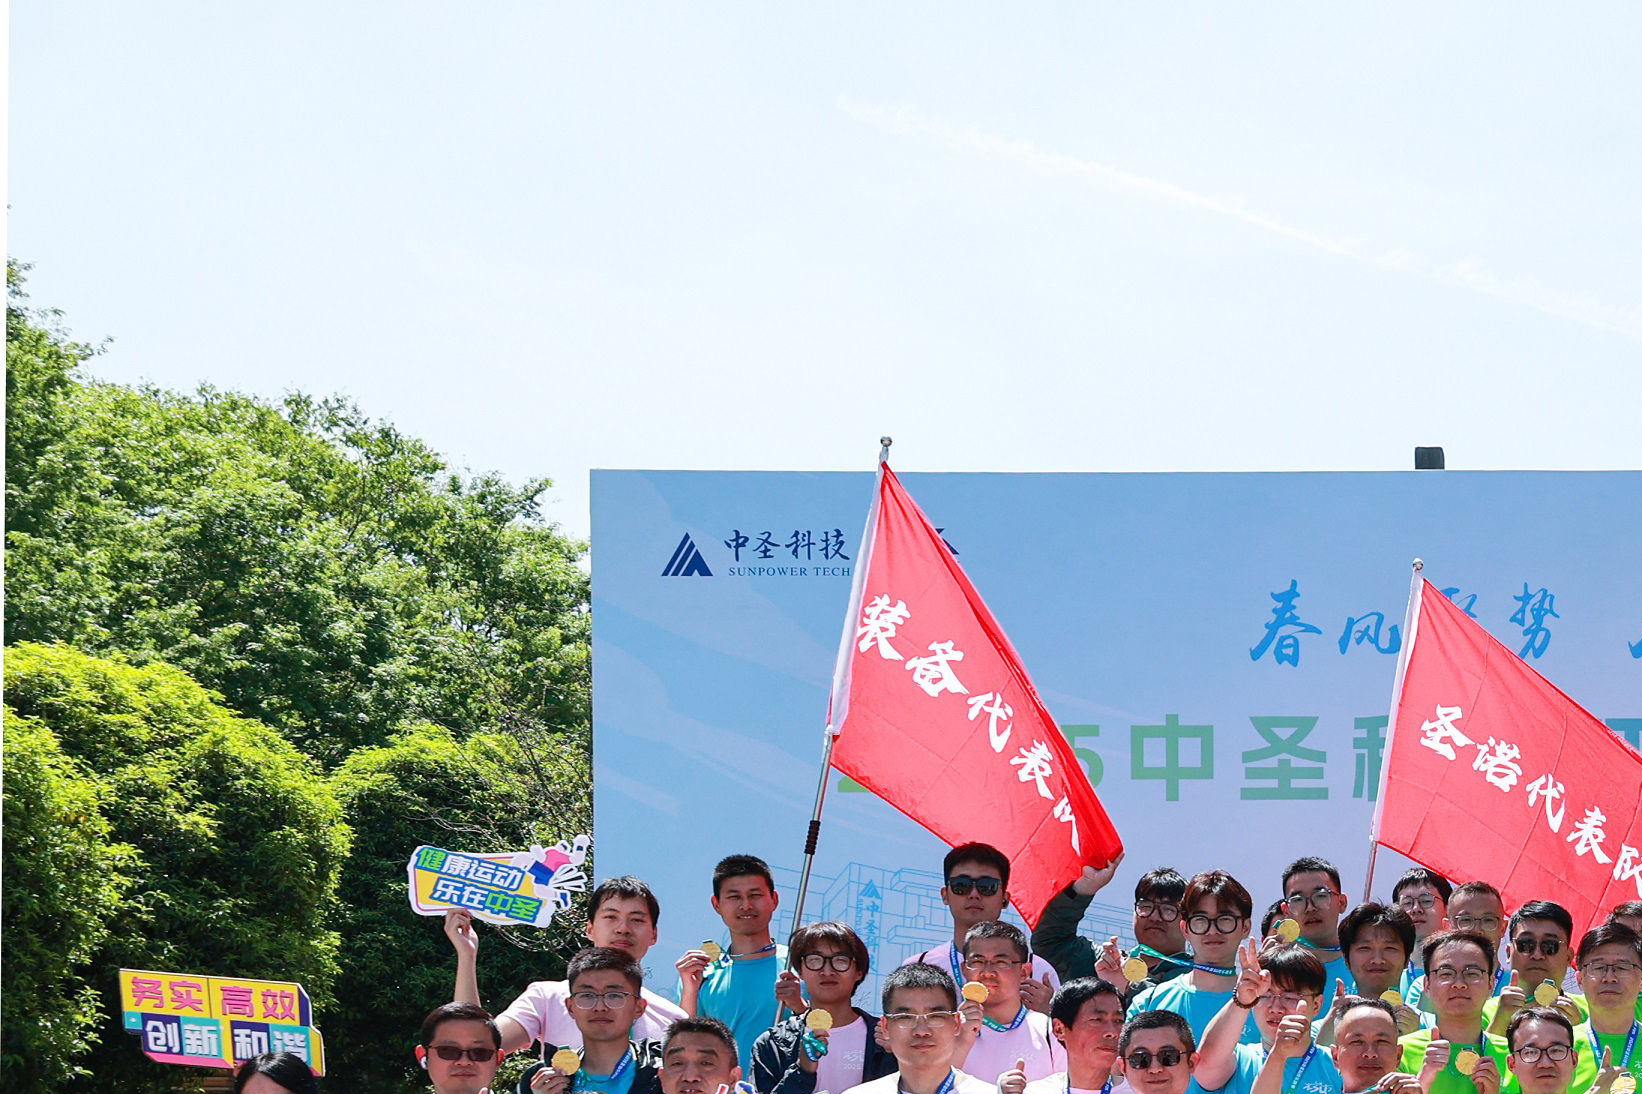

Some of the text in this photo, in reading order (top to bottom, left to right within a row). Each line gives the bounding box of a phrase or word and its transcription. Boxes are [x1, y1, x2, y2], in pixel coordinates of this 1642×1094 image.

[724, 529, 850, 562] 中圣科技
[728, 566, 850, 577] SUNPOWER TECH
[1250, 579, 1561, 668] 春风势
[417, 848, 524, 890] 健康运动
[433, 879, 541, 922] 乐在中圣
[131, 976, 296, 1021] 务实 高效
[145, 1020, 308, 1063] 创新 和谐
